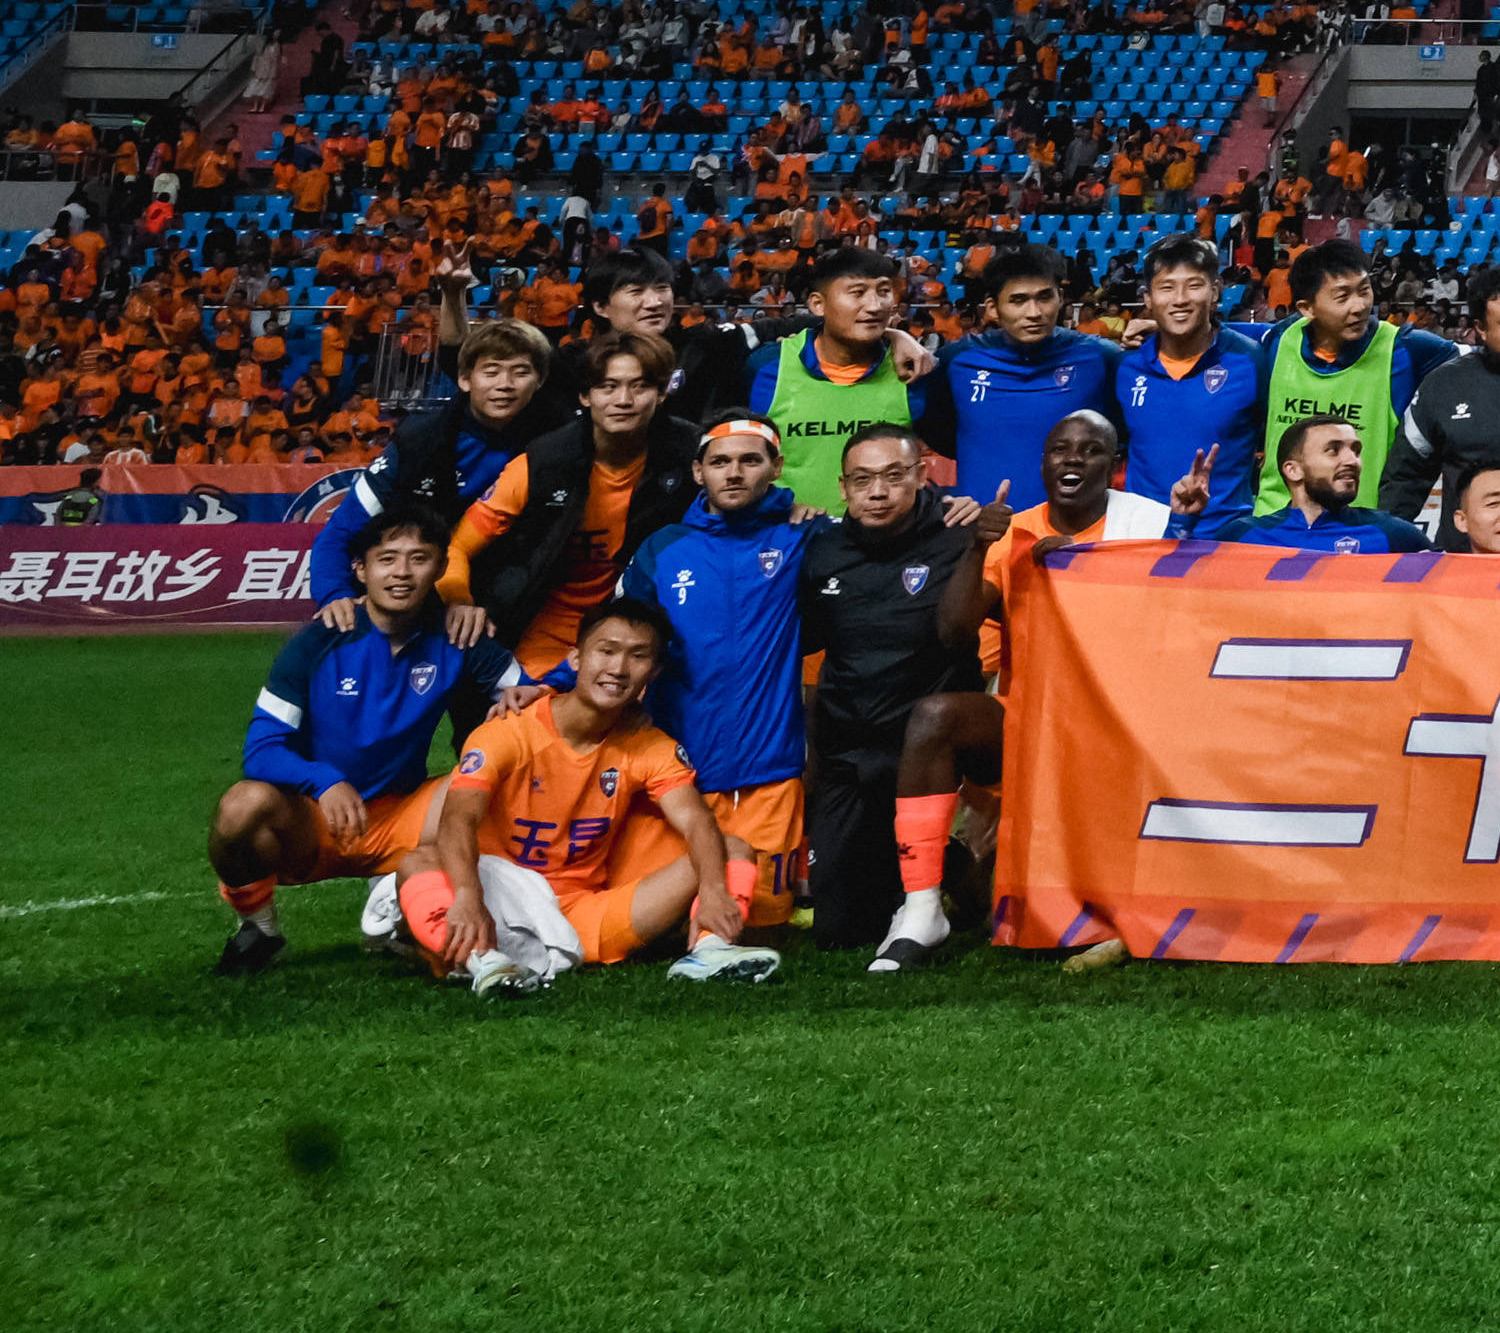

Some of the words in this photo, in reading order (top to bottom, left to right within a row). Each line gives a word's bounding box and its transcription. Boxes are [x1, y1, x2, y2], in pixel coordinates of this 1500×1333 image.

[971, 385, 987, 402] 21
[1284, 397, 1363, 420] KELME
[787, 420, 872, 437] KELME
[0, 548, 222, 603] 聂耳故乡
[678, 587, 687, 605] 9
